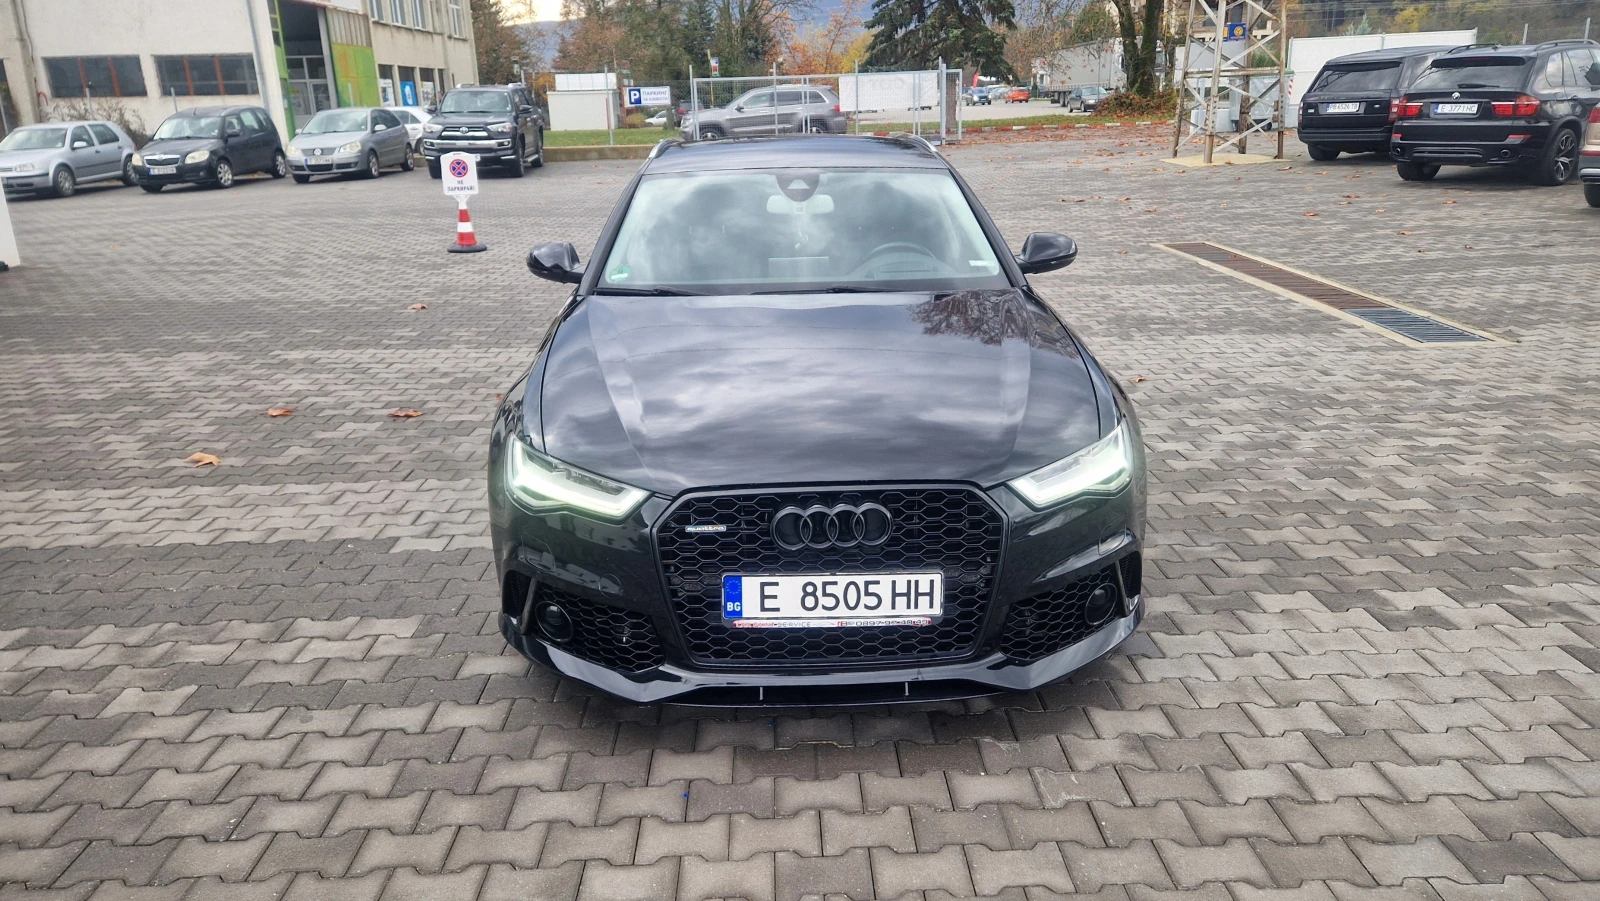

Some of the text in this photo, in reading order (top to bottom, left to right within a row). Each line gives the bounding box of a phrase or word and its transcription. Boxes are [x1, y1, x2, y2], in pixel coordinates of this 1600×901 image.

[630, 90, 640, 103] P
[726, 579, 935, 613] BG E 8505 HH
